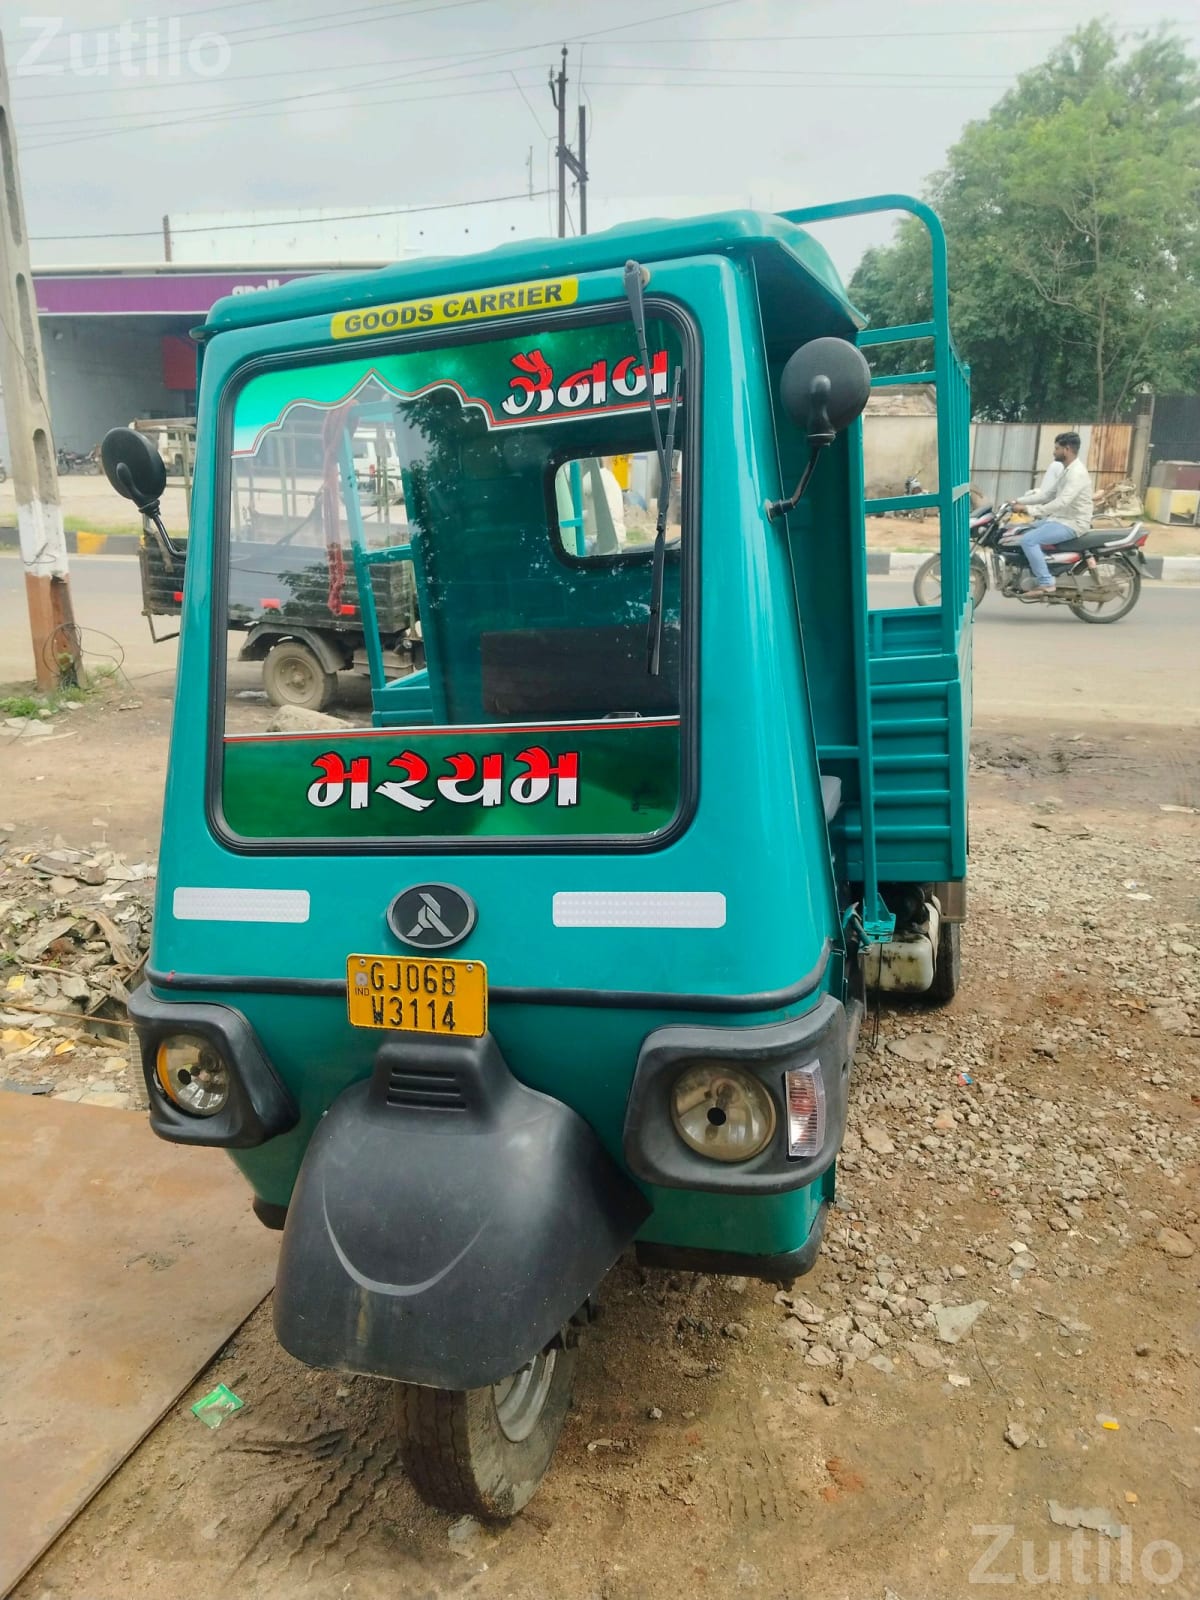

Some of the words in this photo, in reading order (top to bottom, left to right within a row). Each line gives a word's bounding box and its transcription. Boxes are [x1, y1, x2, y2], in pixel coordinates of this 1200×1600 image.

[344, 302, 434, 333] GOODS
[442, 283, 563, 318] CARRIER
[501, 348, 669, 416] ઝૈનબ
[305, 745, 581, 813] મરયમ
[354, 986, 371, 998] IND
[370, 961, 457, 996] GJ06B
[370, 994, 457, 1032] W3114
